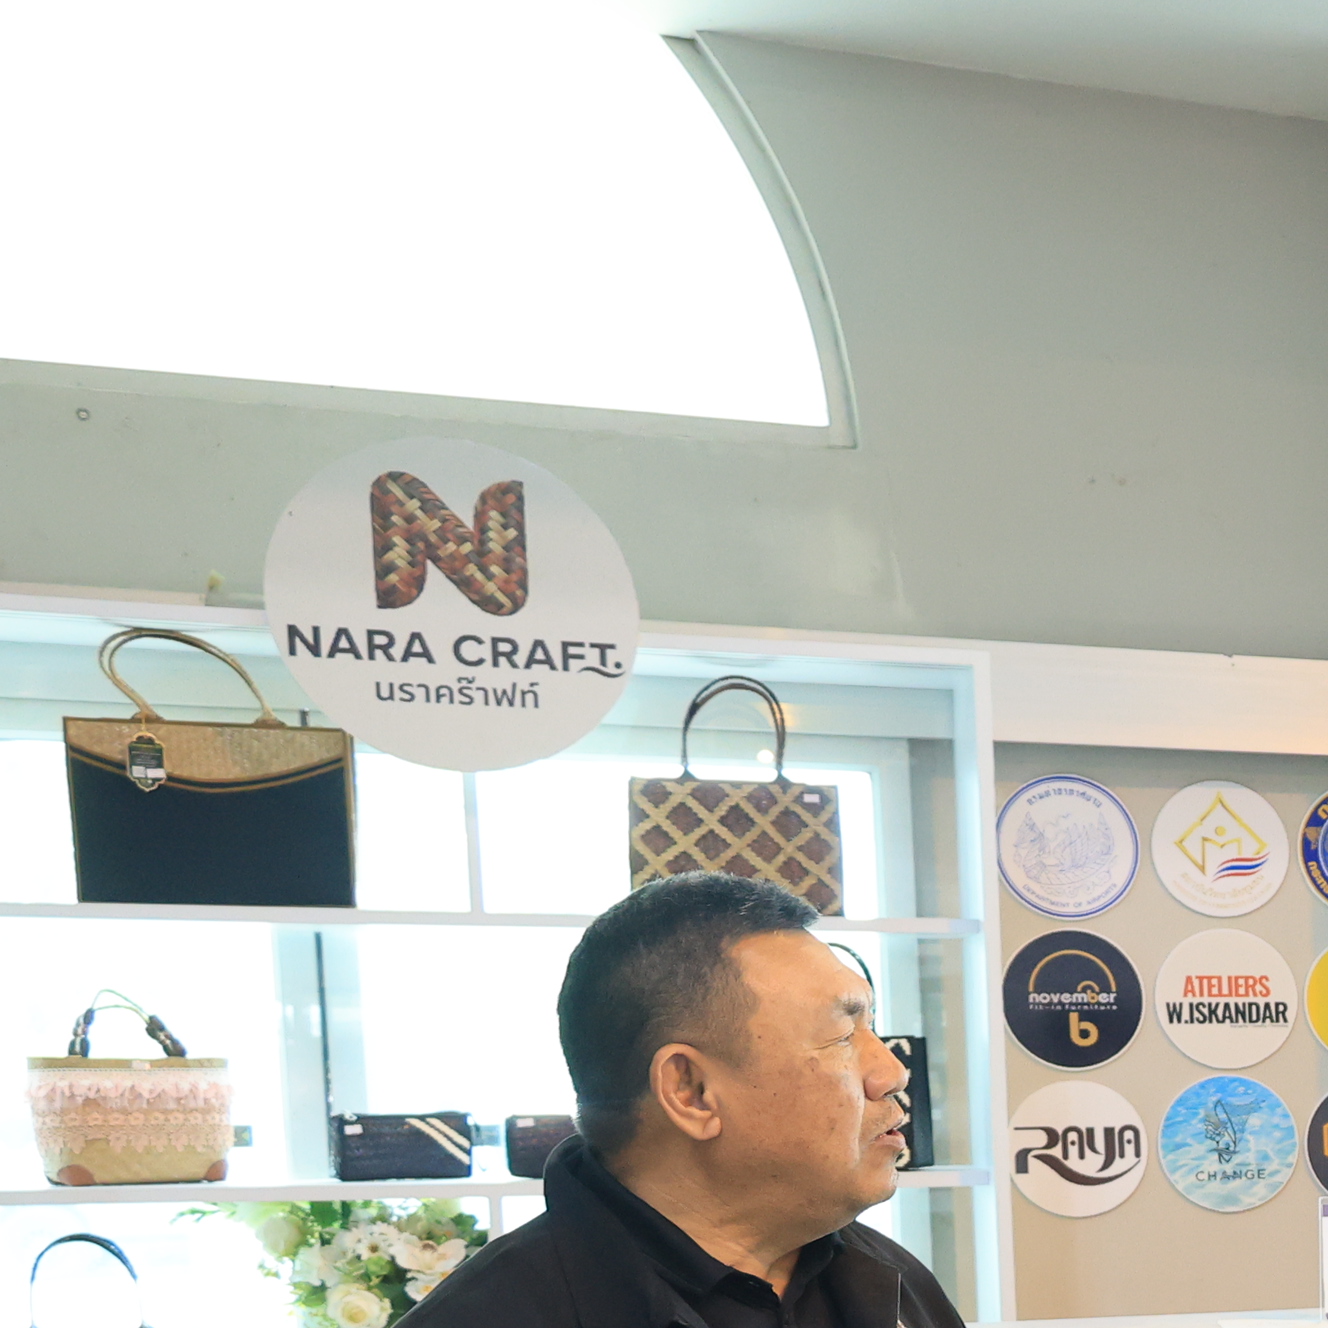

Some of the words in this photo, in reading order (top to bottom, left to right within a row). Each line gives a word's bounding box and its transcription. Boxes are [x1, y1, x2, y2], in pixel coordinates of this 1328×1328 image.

[286, 623, 437, 665] NARA
[375, 676, 540, 709] นราคร๊าฟท์
[1028, 989, 1117, 1004] november
[1183, 975, 1271, 998] ATELIERS
[1166, 1002, 1289, 1024] W.ISKANDAR
[1195, 1168, 1267, 1182] CHANGE
